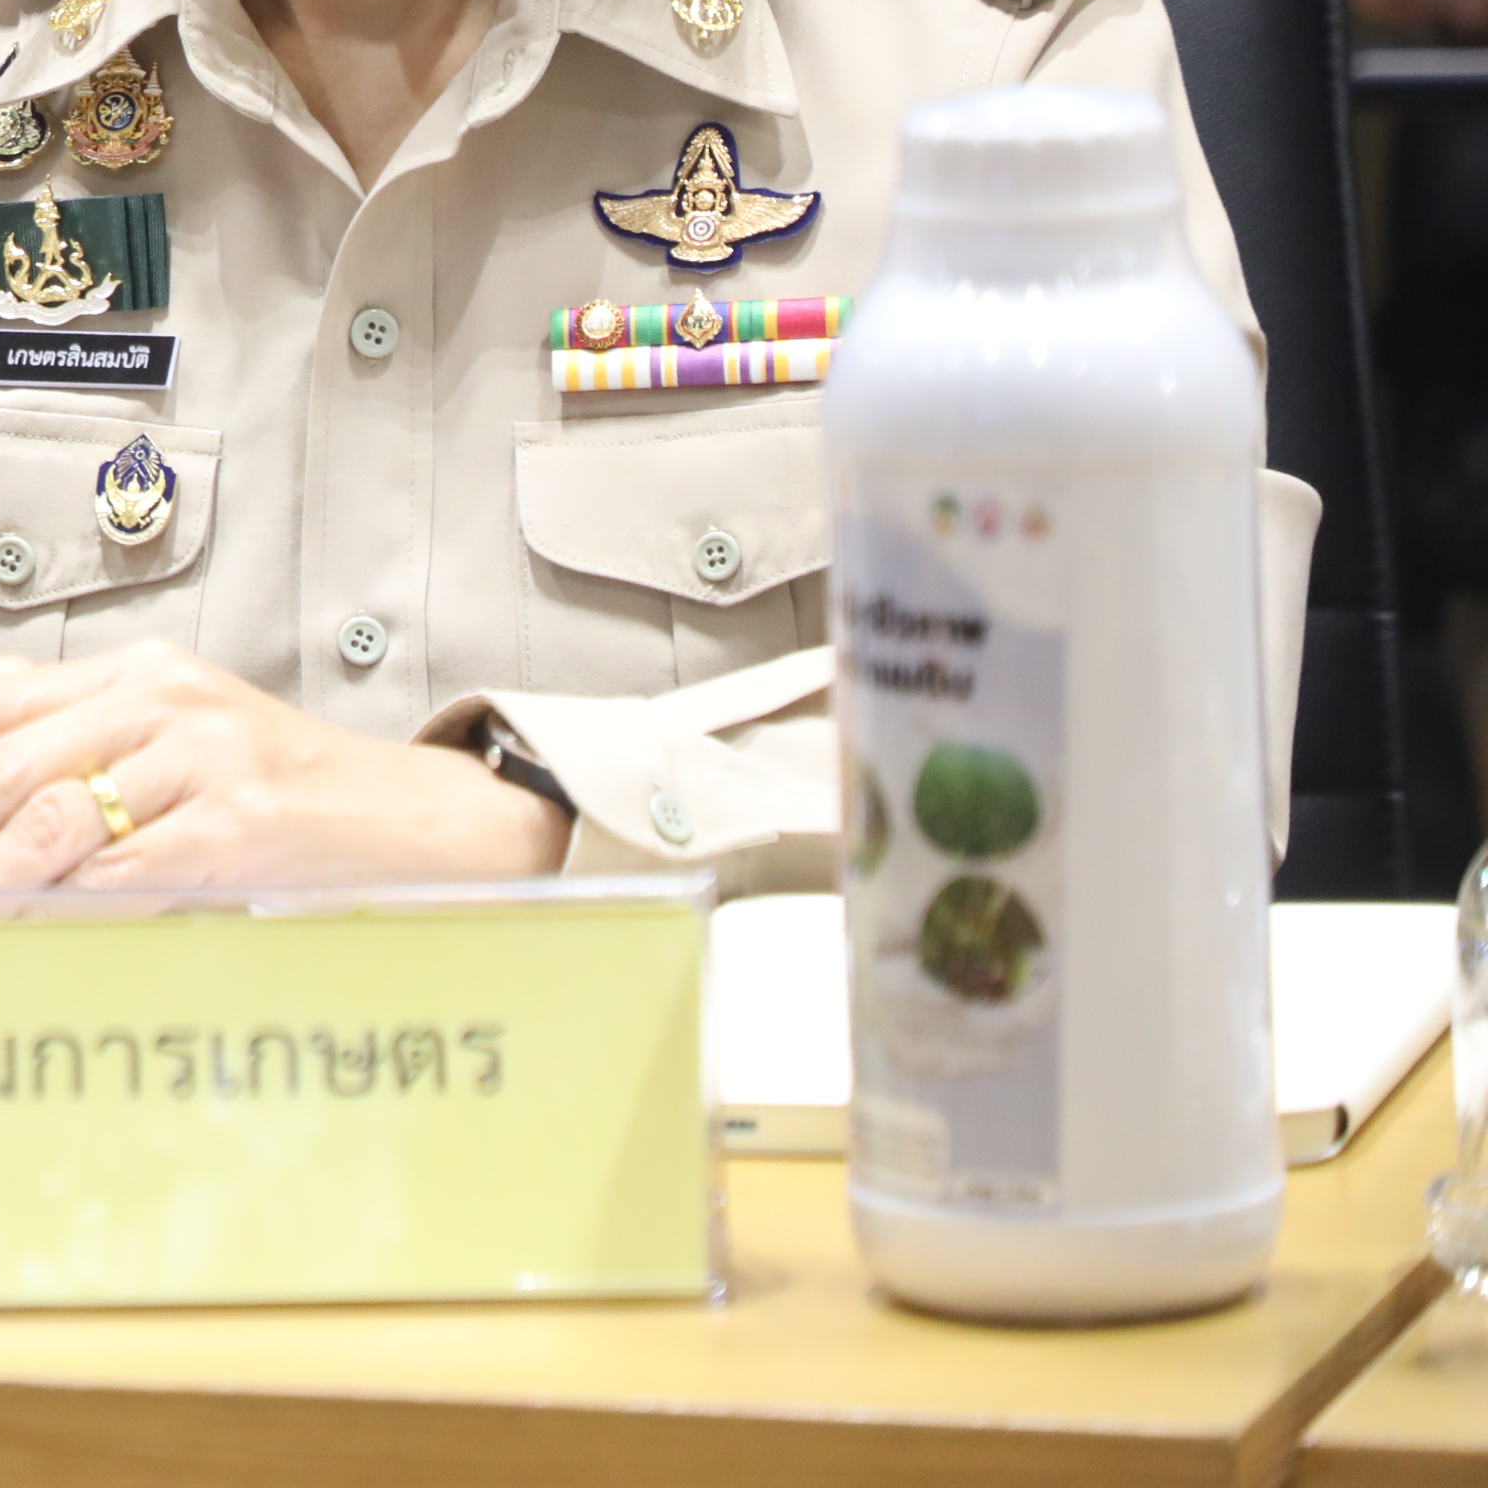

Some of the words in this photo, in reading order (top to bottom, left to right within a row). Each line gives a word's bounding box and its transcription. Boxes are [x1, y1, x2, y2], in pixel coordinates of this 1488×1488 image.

[7, 343, 151, 369] เกษตรสินสมบัติ
